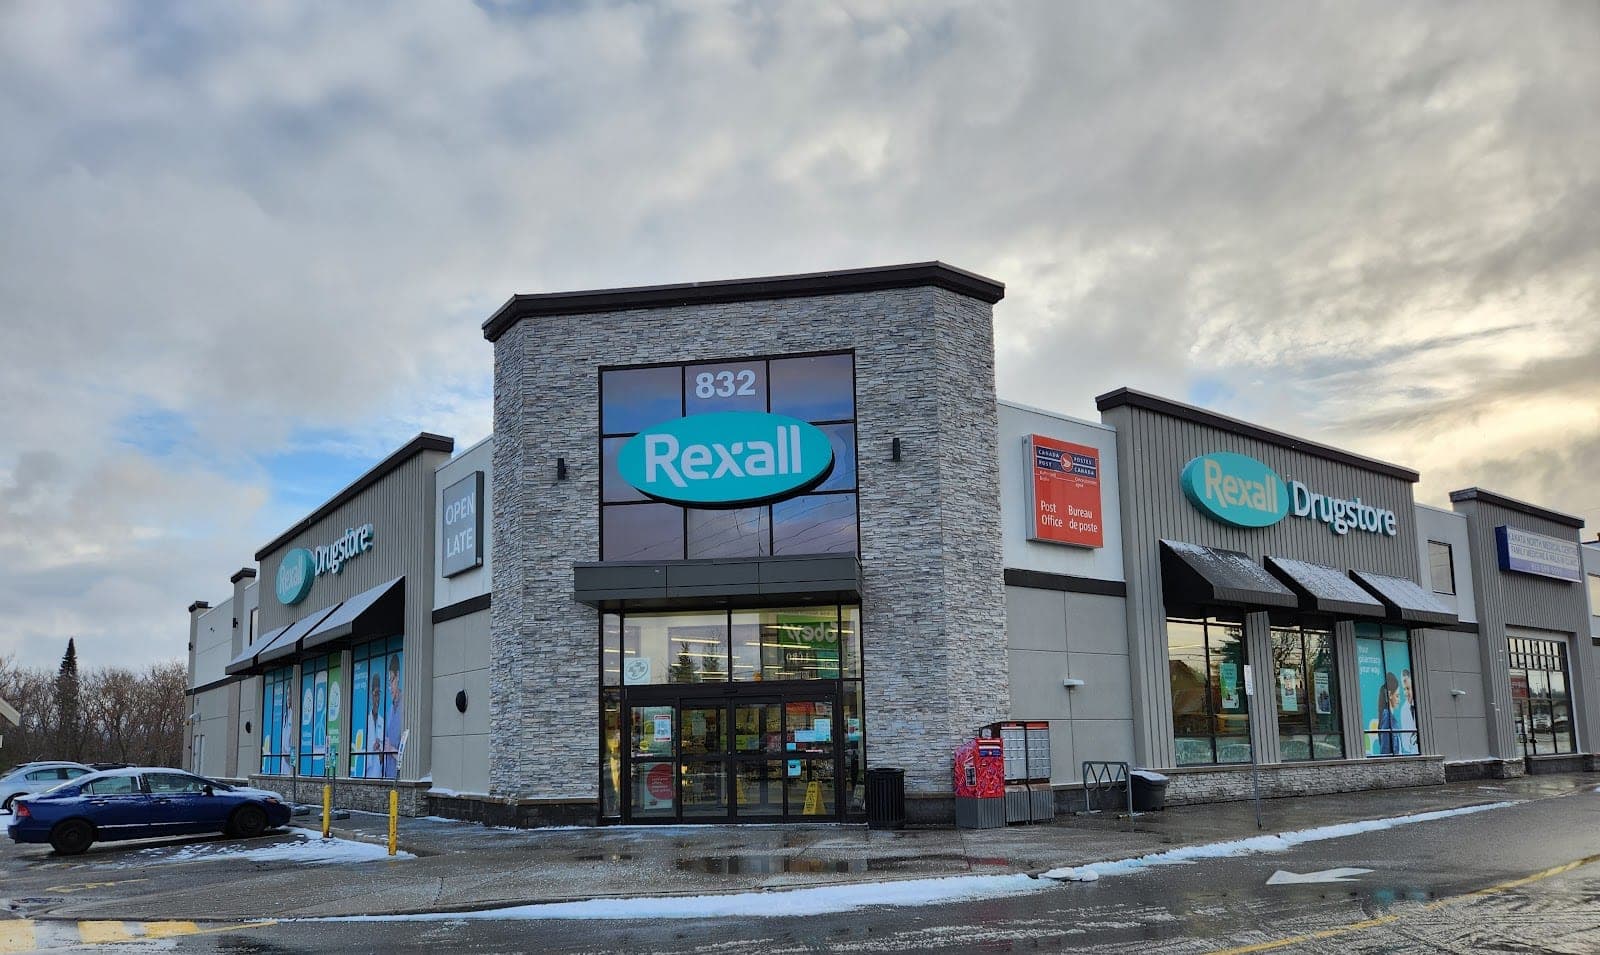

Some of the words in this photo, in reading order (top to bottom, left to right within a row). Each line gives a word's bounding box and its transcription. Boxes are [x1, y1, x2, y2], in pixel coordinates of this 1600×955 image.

[695, 369, 756, 399] 832
[644, 424, 802, 488] Rexall
[1038, 449, 1060, 458] CANADA
[1073, 456, 1092, 465] POSTES
[1074, 466, 1095, 476] CANADA
[1203, 458, 1279, 514] Rexall
[1290, 479, 1397, 537] Drugstore
[445, 492, 475, 526] OPEN
[1040, 499, 1057, 513] Post
[1068, 505, 1093, 519] Bureau
[1041, 514, 1063, 528] Office
[1069, 518, 1078, 530] de
[1079, 521, 1098, 534] poste
[446, 527, 473, 558] LATE
[279, 551, 304, 596] Rexall
[314, 523, 374, 577] Drugstore
